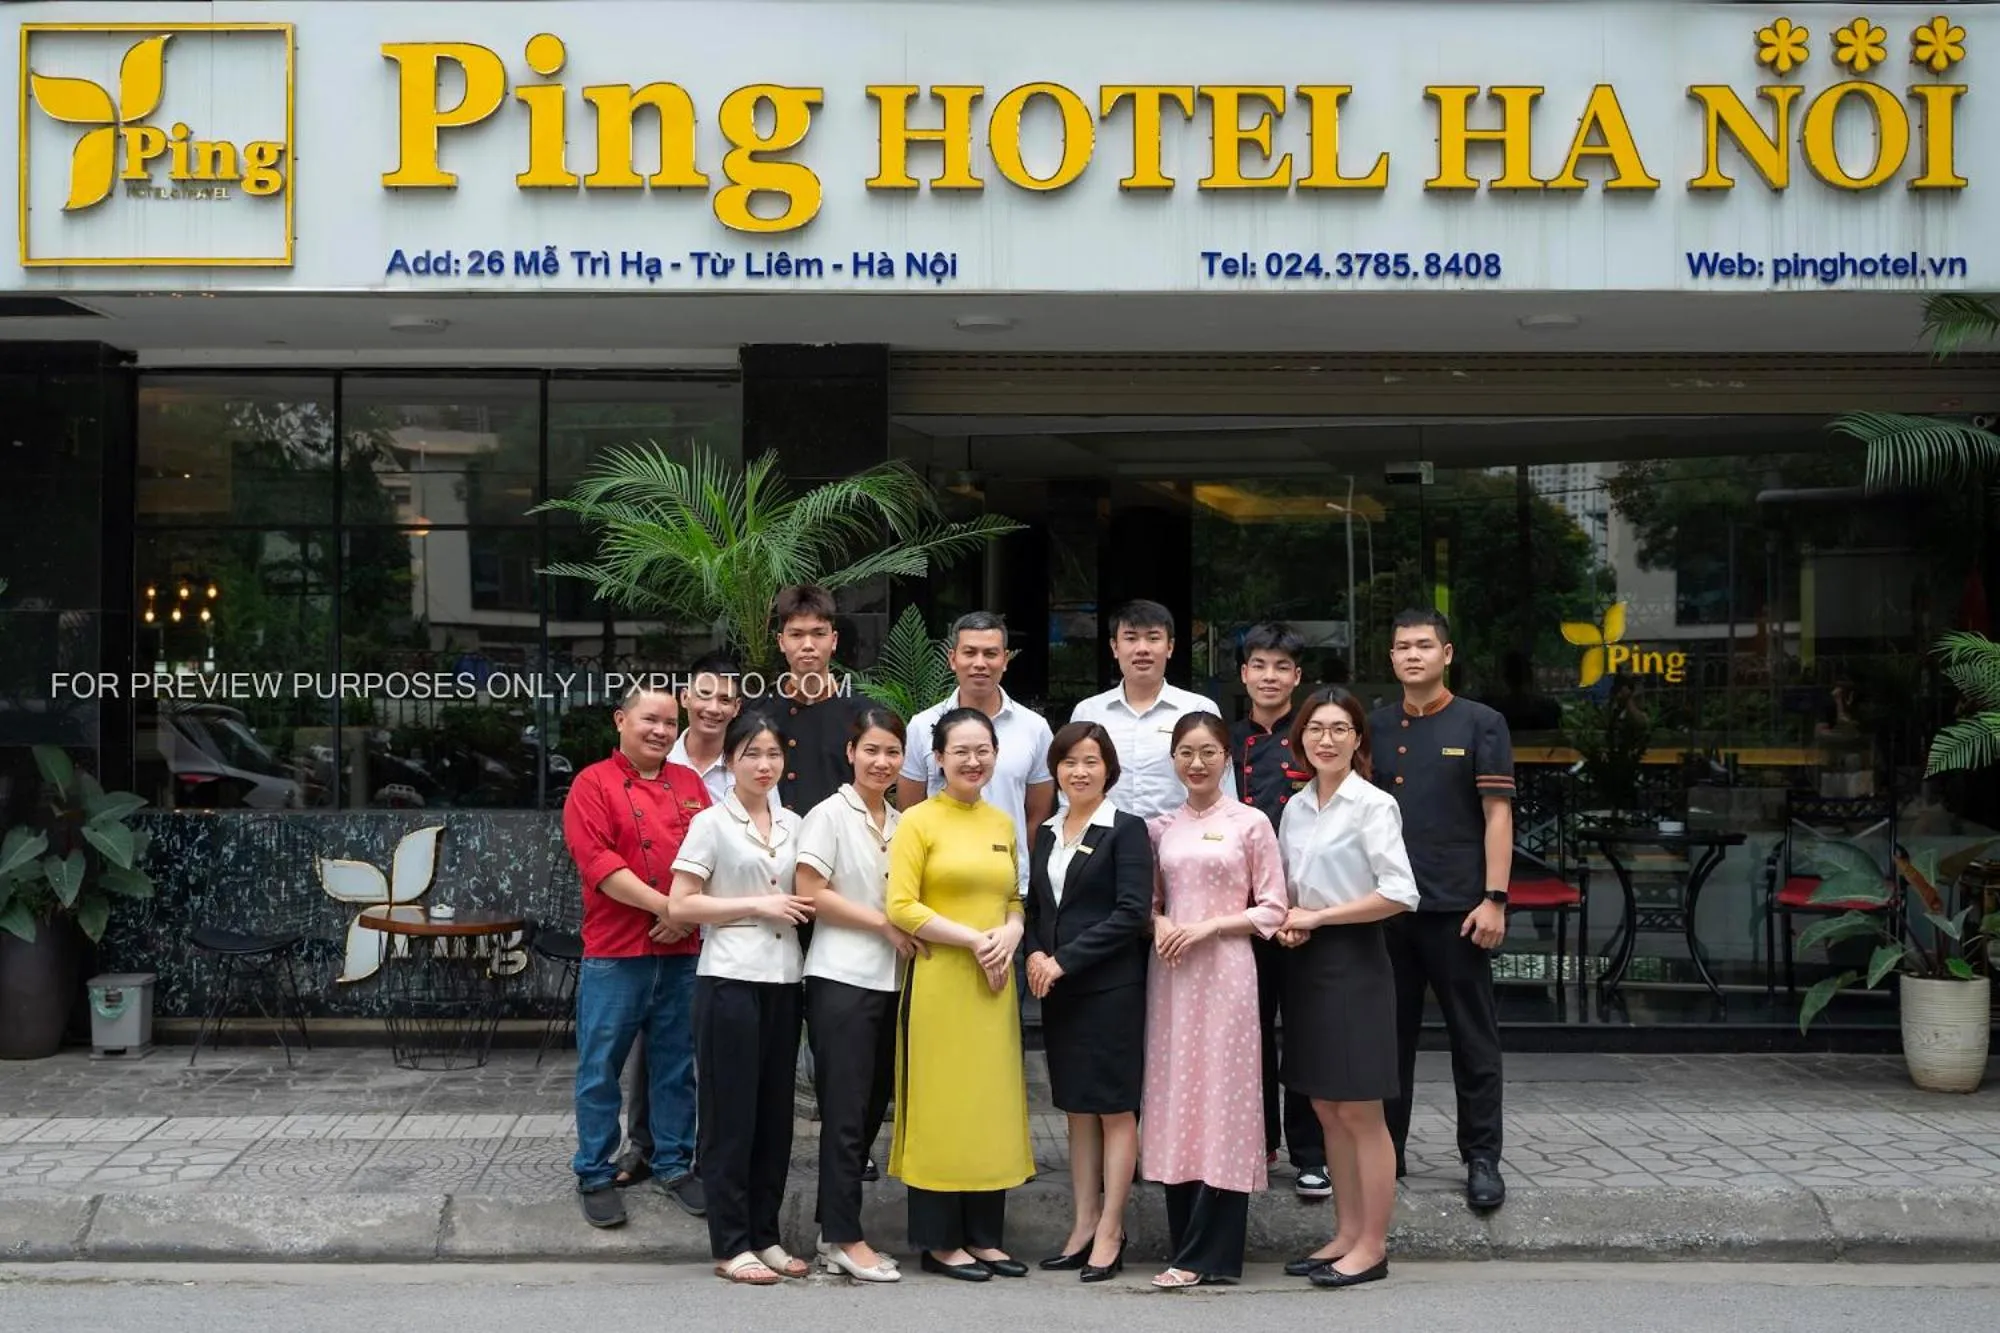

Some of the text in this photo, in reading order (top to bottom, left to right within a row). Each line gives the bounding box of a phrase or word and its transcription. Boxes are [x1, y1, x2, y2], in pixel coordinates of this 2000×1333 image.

[381, 33, 823, 232] Ping
[866, 82, 1389, 190] HOTEL
[119, 122, 286, 197] Ping
[386, 249, 460, 277] Add:
[467, 250, 505, 277] 26
[514, 245, 560, 277] Mễ
[570, 250, 610, 277] Trì
[621, 250, 662, 283] Hạ
[690, 251, 735, 278] Từ
[746, 250, 824, 279] Liêm
[853, 250, 895, 278] Hà
[906, 251, 957, 284] Nội
[1202, 251, 1258, 279] Tel:
[1686, 251, 1968, 284] Web: pinghotel.vn
[1606, 641, 1687, 684] Ping
